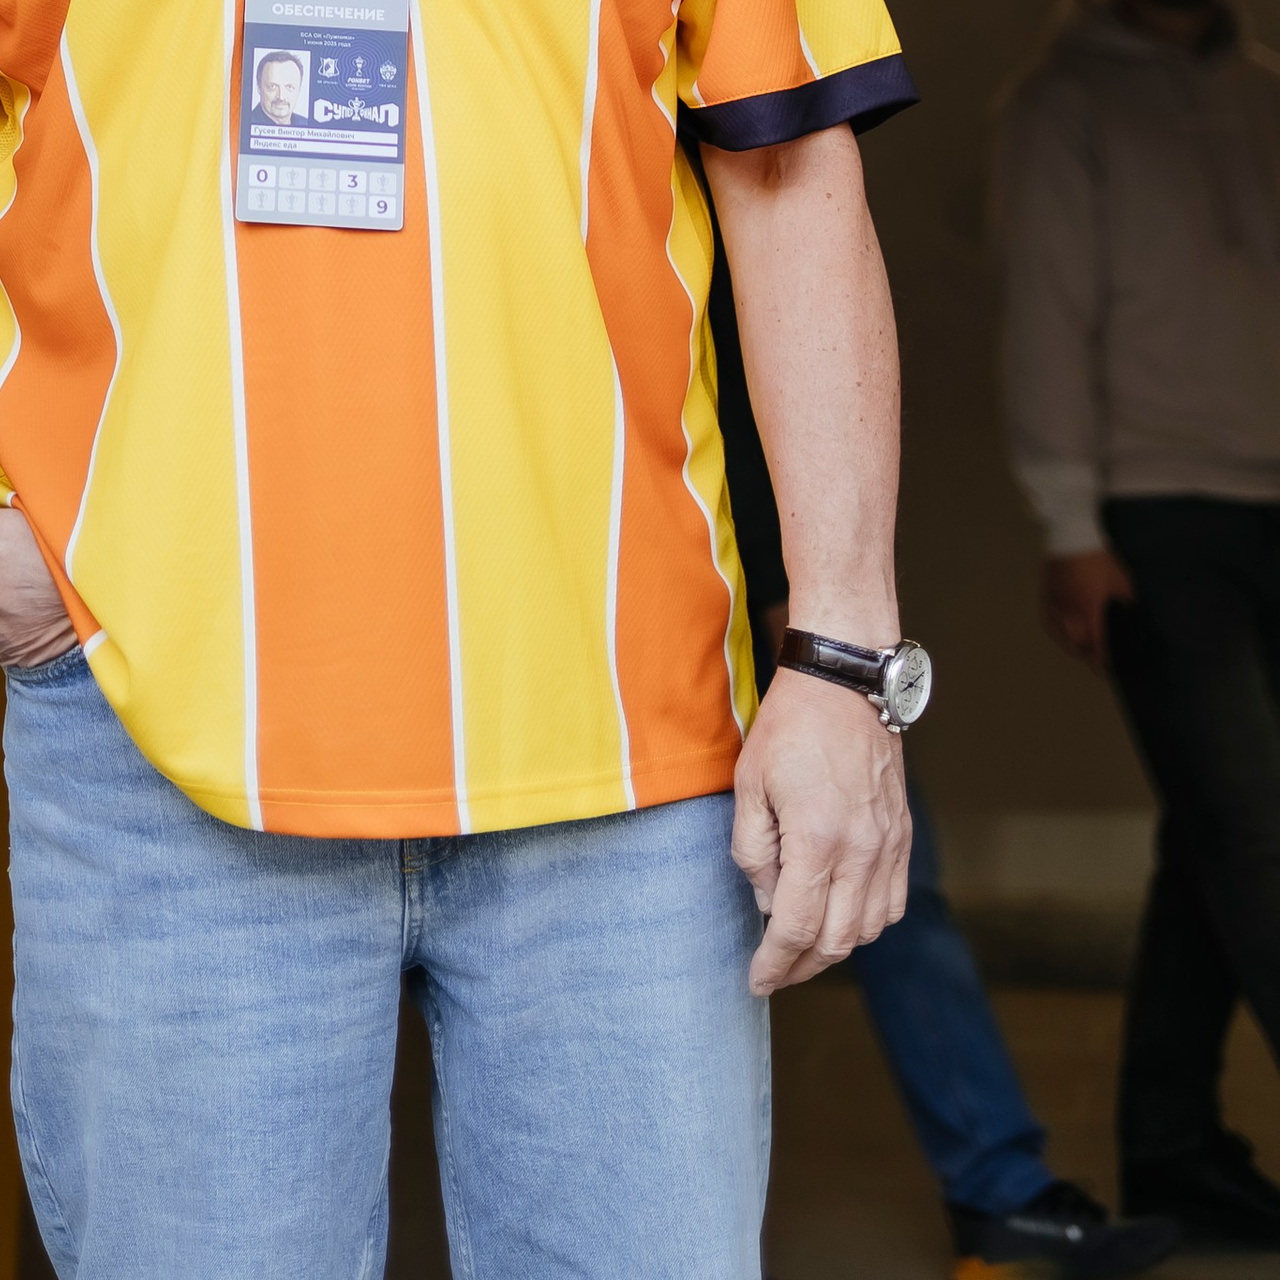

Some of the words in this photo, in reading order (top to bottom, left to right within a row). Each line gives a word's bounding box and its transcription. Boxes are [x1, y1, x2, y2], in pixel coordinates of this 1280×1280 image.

[272, 3, 385, 22] ОБЕСПЕЧЕНИЕ
[256, 169, 268, 183] 0
[347, 174, 358, 188] 3
[376, 200, 388, 214] 9
